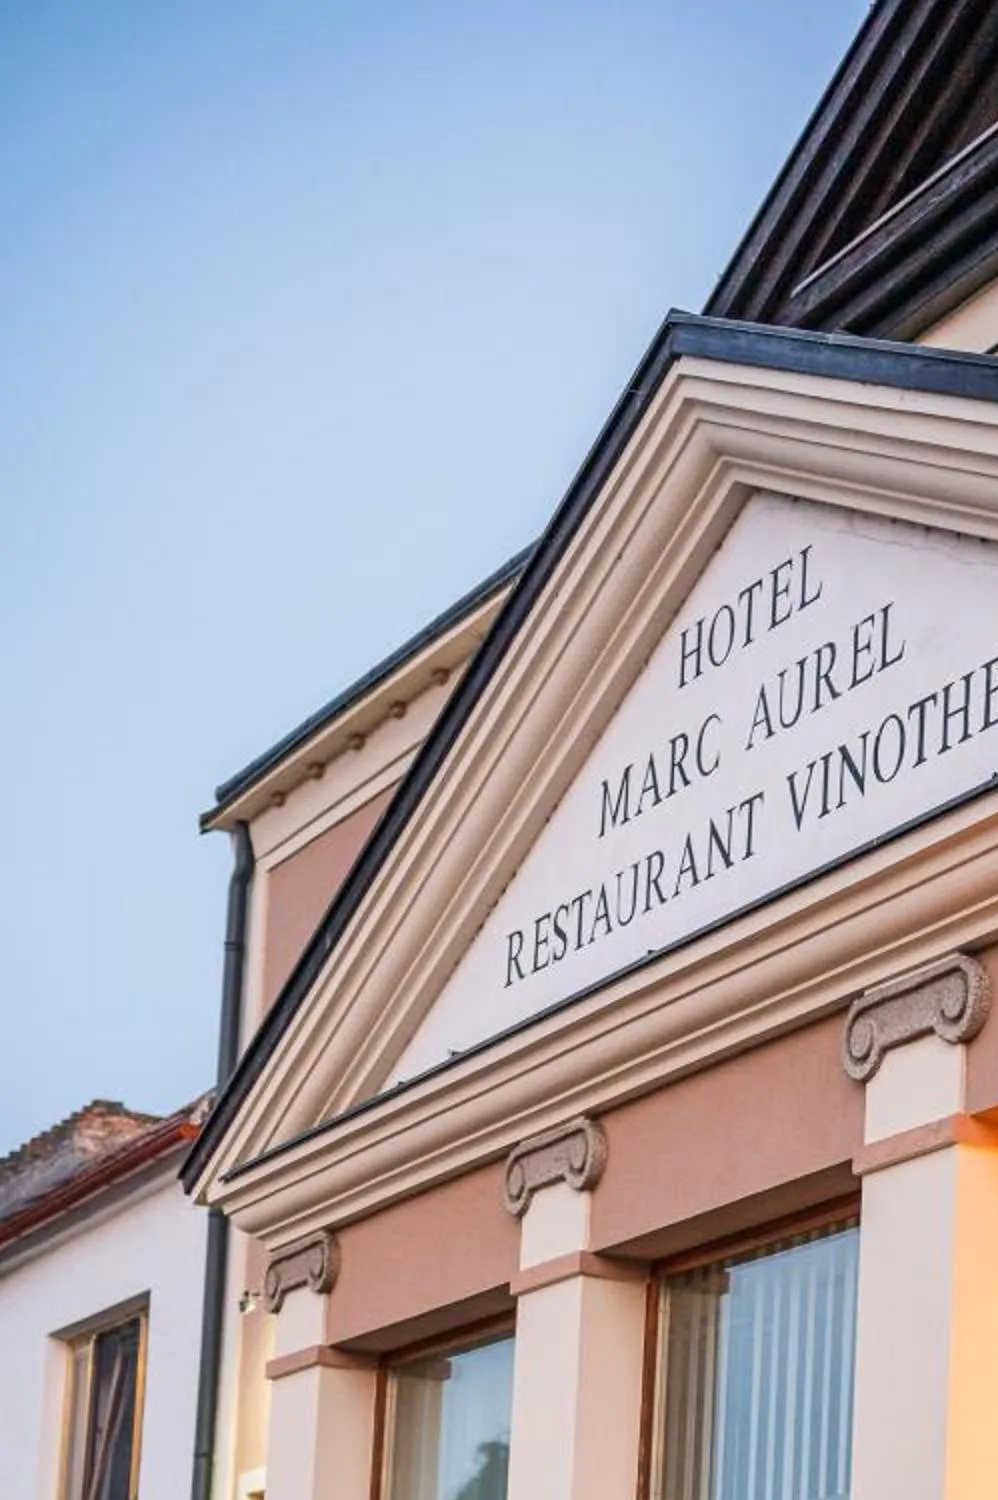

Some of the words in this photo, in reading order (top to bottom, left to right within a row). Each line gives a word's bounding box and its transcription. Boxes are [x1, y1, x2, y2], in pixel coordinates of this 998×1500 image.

[678, 545, 823, 689] HOTEL
[598, 713, 722, 839] MARC
[744, 601, 907, 752] AUREL
[503, 790, 765, 989] RESTAURANT
